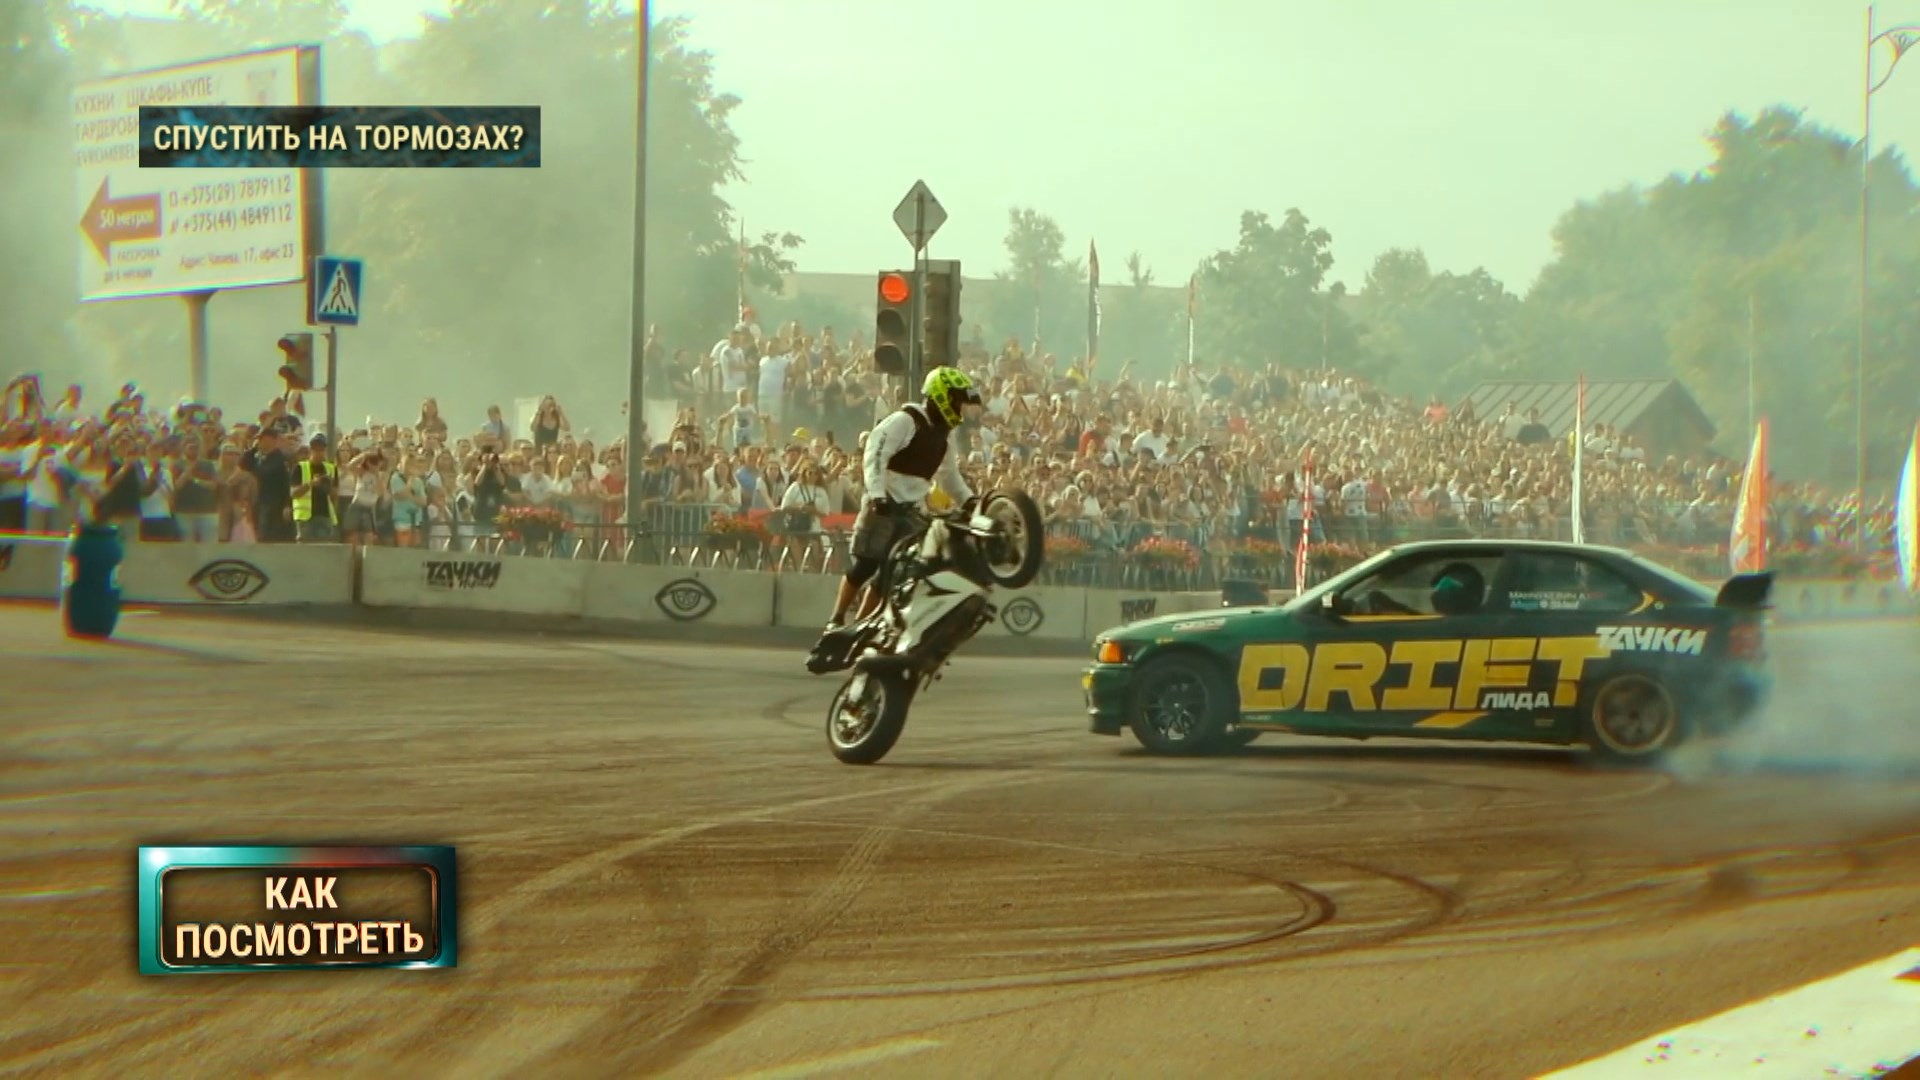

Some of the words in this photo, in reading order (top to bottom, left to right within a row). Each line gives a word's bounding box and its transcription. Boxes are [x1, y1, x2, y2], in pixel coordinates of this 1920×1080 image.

[75, 93, 115, 114] КУХНИ
[126, 77, 213, 106] ШКАФЫ-КУПЕ
[182, 182, 236, 206] +375(29)
[240, 174, 291, 199] 7879112
[100, 208, 115, 229] 50
[182, 209, 238, 233] +375(44)
[240, 203, 293, 227] 4849112
[1595, 626, 1708, 656] ТАЧКИ
[1237, 637, 1612, 713] DRIFT
[1481, 691, 1551, 711] ЛИДА
